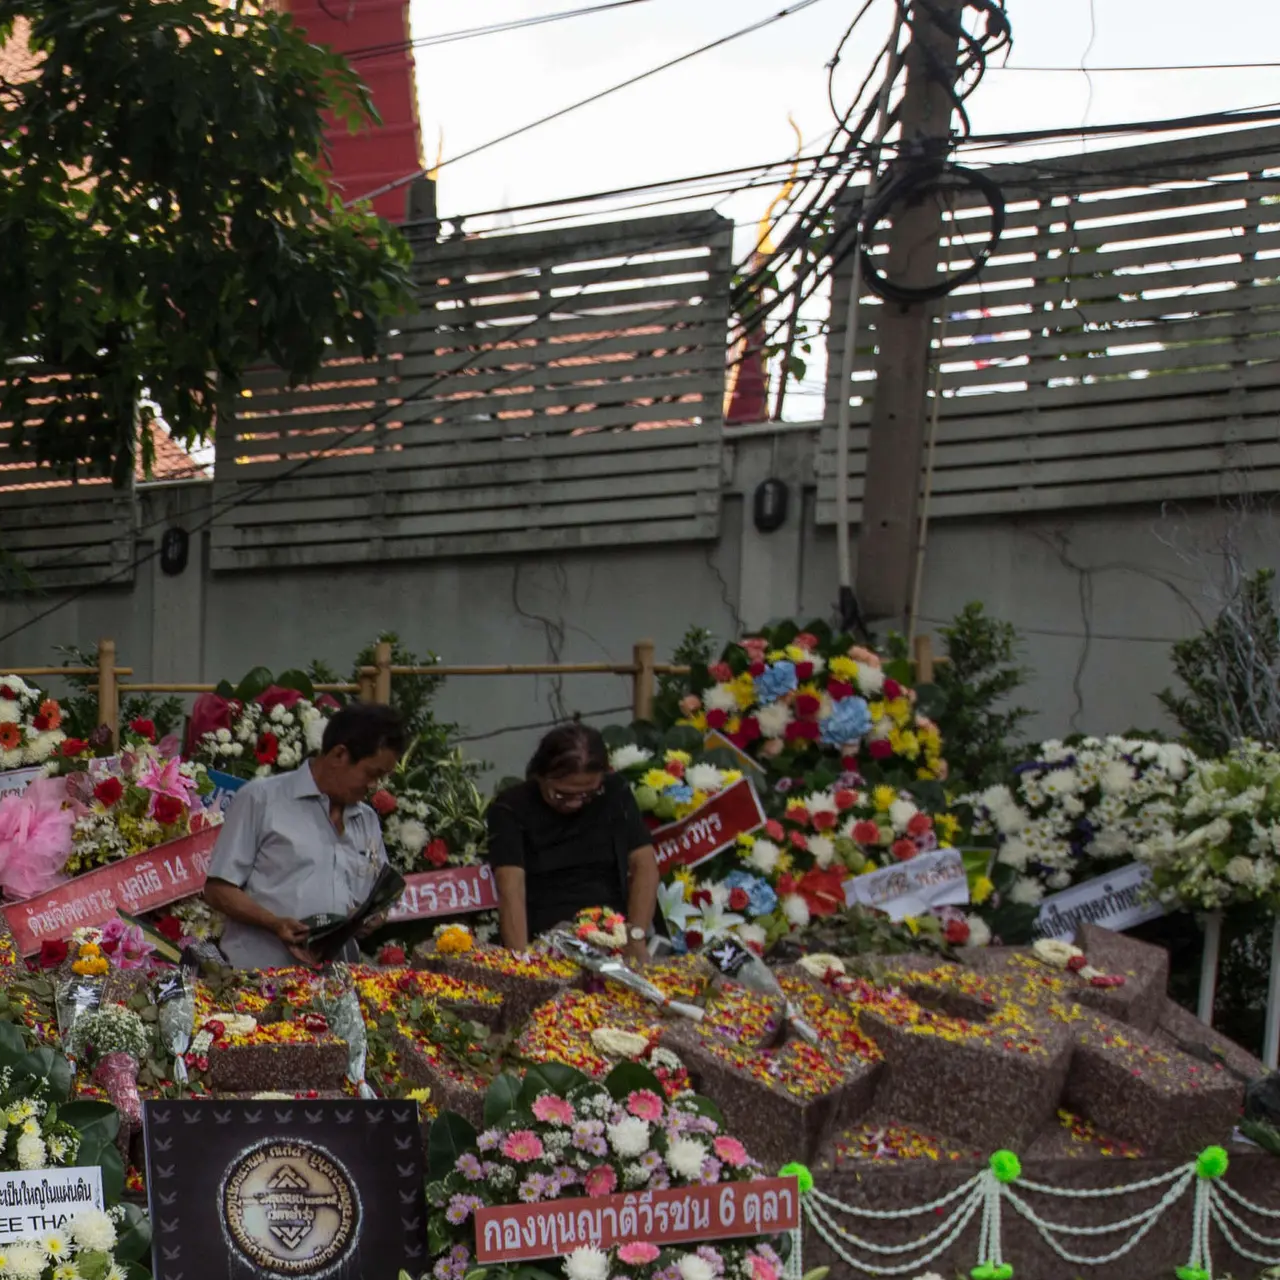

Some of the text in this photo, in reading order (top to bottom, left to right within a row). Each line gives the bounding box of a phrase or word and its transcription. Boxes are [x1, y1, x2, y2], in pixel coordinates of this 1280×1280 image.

[163, 855, 189, 885] 14
[28, 1213, 74, 1231] THA
[483, 1186, 792, 1252] กองทุนญาติวีรชน 6 ตุลา
